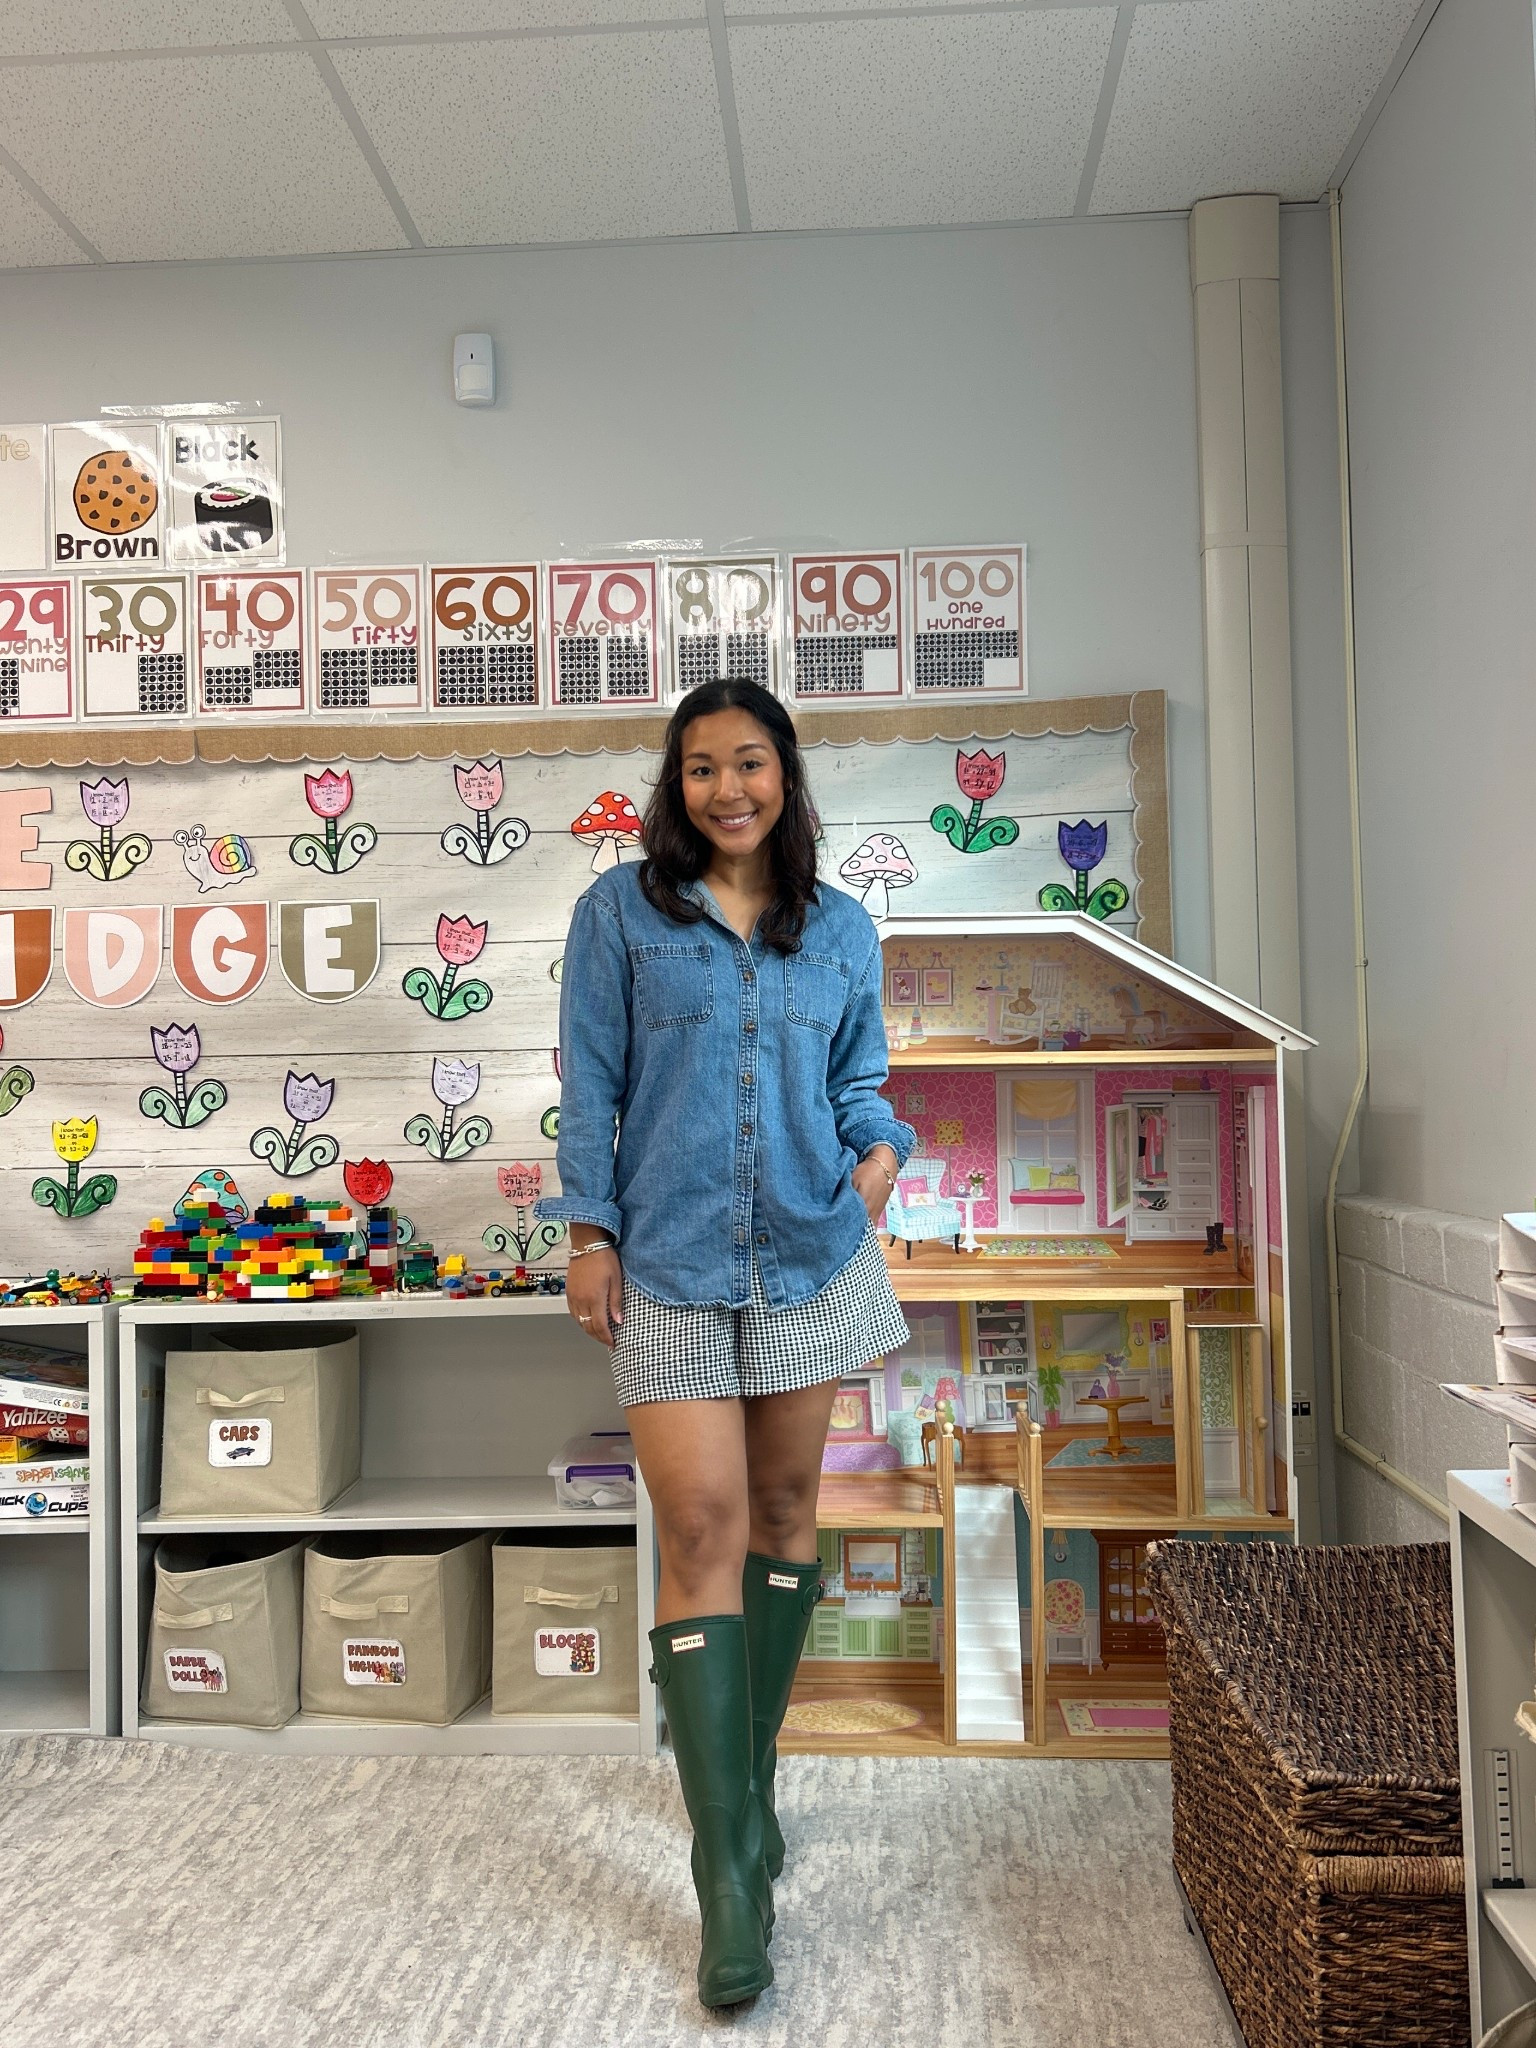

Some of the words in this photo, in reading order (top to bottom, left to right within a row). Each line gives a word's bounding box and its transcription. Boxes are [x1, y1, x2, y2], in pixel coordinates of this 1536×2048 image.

[56, 533, 158, 560] Brown
[800, 564, 892, 616] 90
[920, 559, 1014, 602] 100
[205, 581, 295, 635] 40
[322, 577, 411, 632] 50
[436, 575, 531, 629] 60
[557, 572, 647, 627] 70
[676, 568, 770, 627] 80
[0, 587, 64, 641] 29
[89, 586, 177, 640] 30
[796, 611, 892, 633] Ninety
[85, 633, 165, 654] Thirty
[201, 628, 275, 649] Forty
[352, 625, 417, 646] Fifty
[20, 657, 68, 674] Nine
[2, 1407, 68, 1428] Yahtzee
[219, 1425, 260, 1442] CARS
[0, 1494, 26, 1506] ICK
[768, 1576, 798, 1586] HUNTER
[347, 1644, 400, 1657] RAINBOW
[539, 1633, 596, 1649] BLOCKS
[672, 1637, 703, 1650] HUNTER
[169, 1655, 207, 1668] BARBIE
